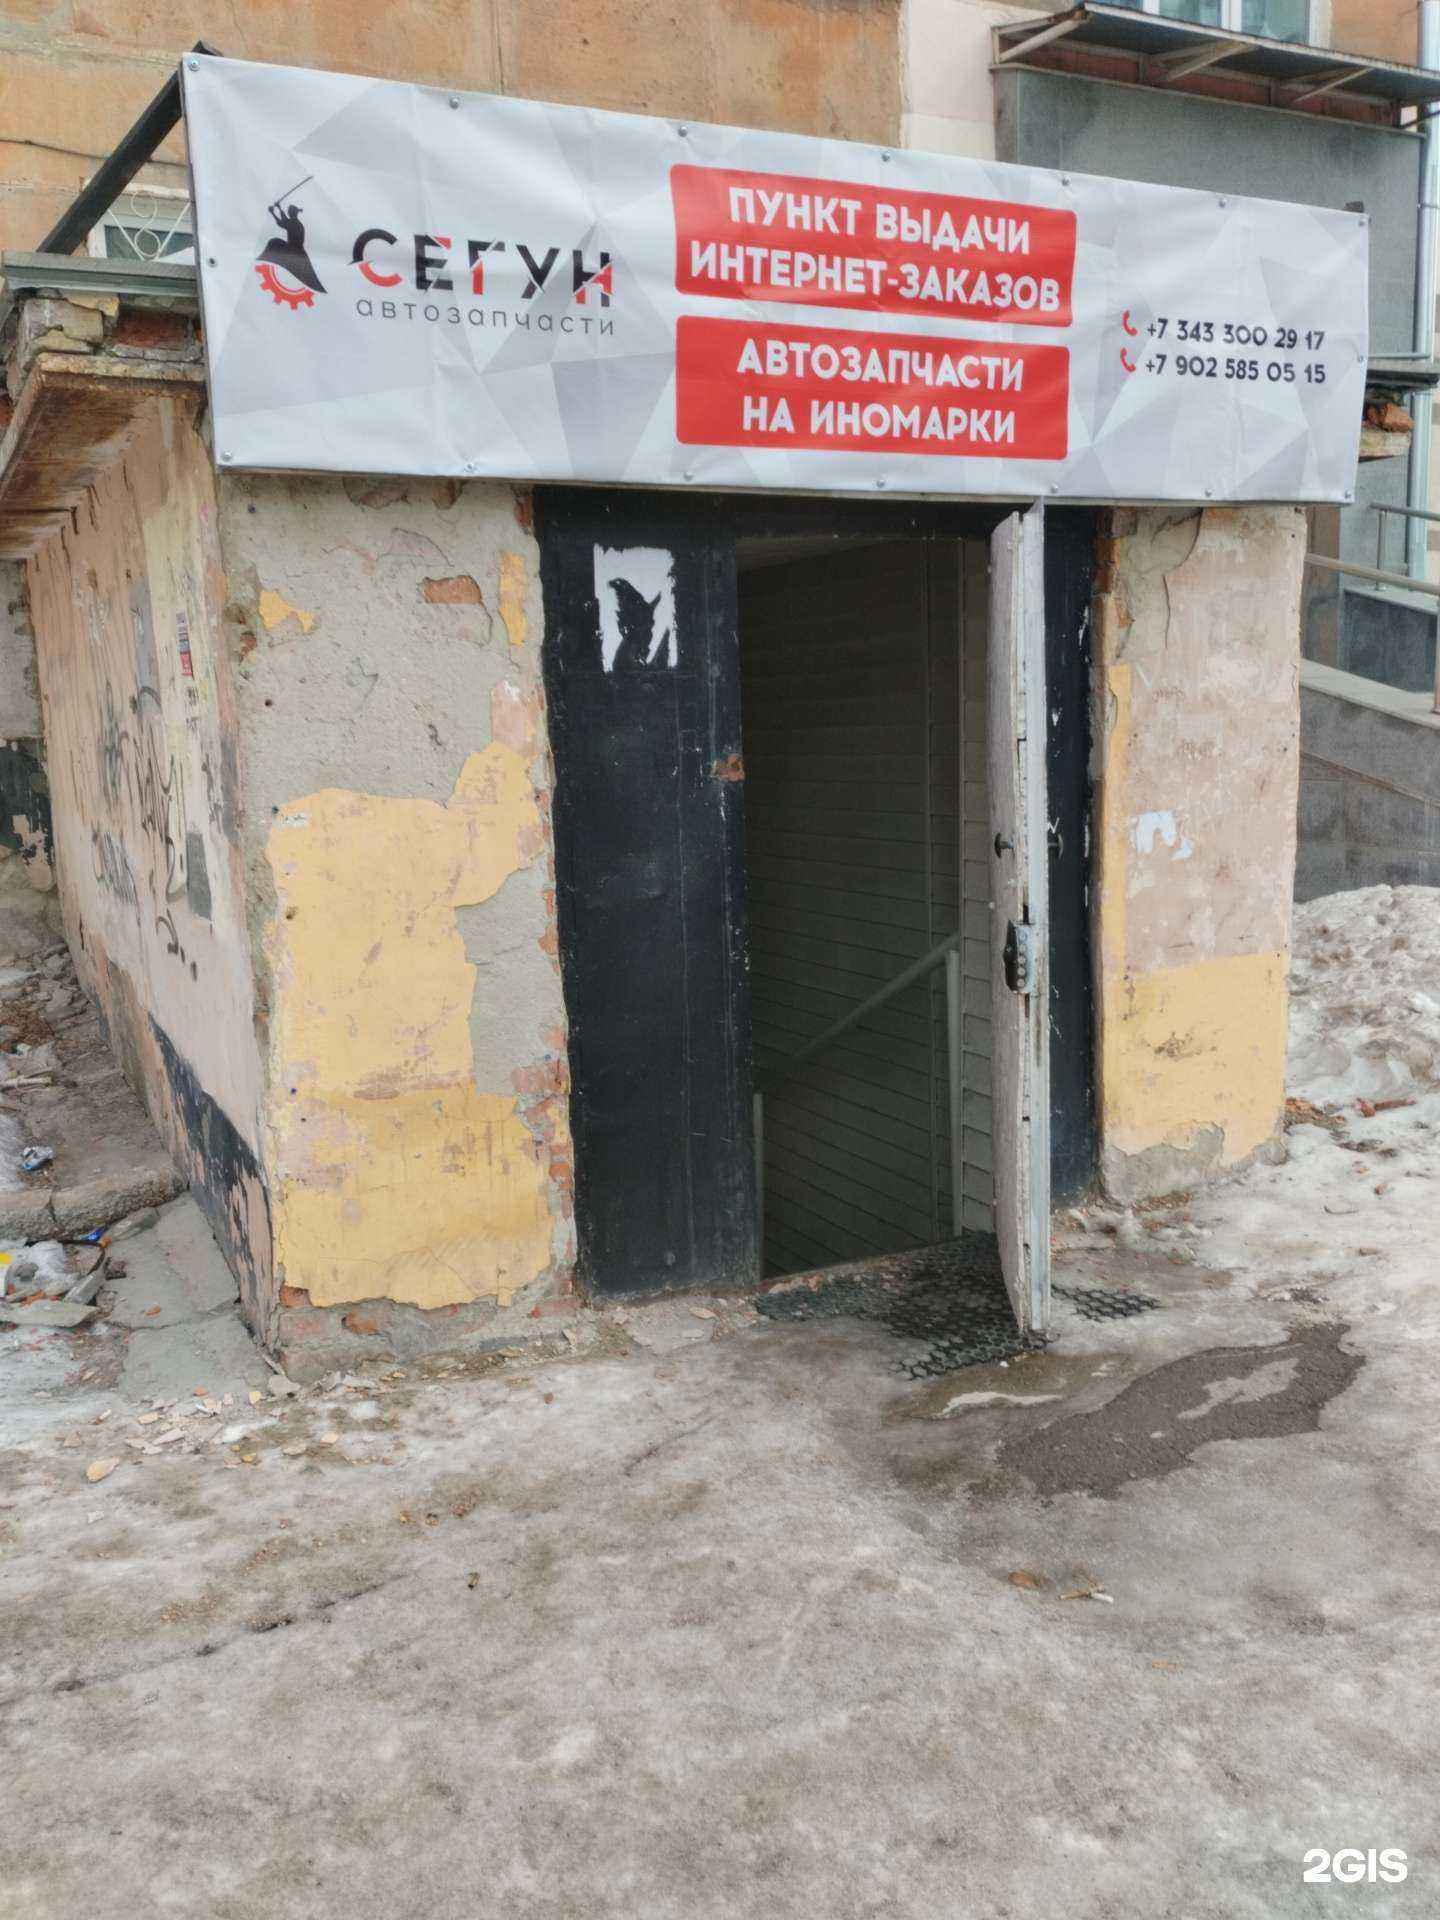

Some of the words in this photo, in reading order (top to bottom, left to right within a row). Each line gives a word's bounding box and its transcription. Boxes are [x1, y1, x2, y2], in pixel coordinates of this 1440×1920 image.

[729, 187, 862, 236] ПУНКТ
[875, 203, 1030, 255] ВЫДАЧИ
[349, 228, 613, 307] СЕГУН
[690, 240, 1060, 312] ИНТЕРНЕТ-ЗАКАЗОВ
[356, 297, 614, 336] автозапчасти
[1147, 318, 1168, 340] +7
[1177, 320, 1214, 343] 343
[1223, 324, 1268, 347] 300
[1274, 327, 1298, 349] 29
[1305, 331, 1325, 350] 17
[736, 338, 1024, 391] АВТОЗАПЧАСТИ
[1146, 354, 1167, 375] +7
[1175, 355, 1218, 378] 902
[1224, 358, 1259, 381] 585
[1266, 362, 1296, 383] 05
[1304, 364, 1326, 384] 15
[742, 395, 795, 433] НА
[810, 399, 1016, 443] ИНОМАРКИ
